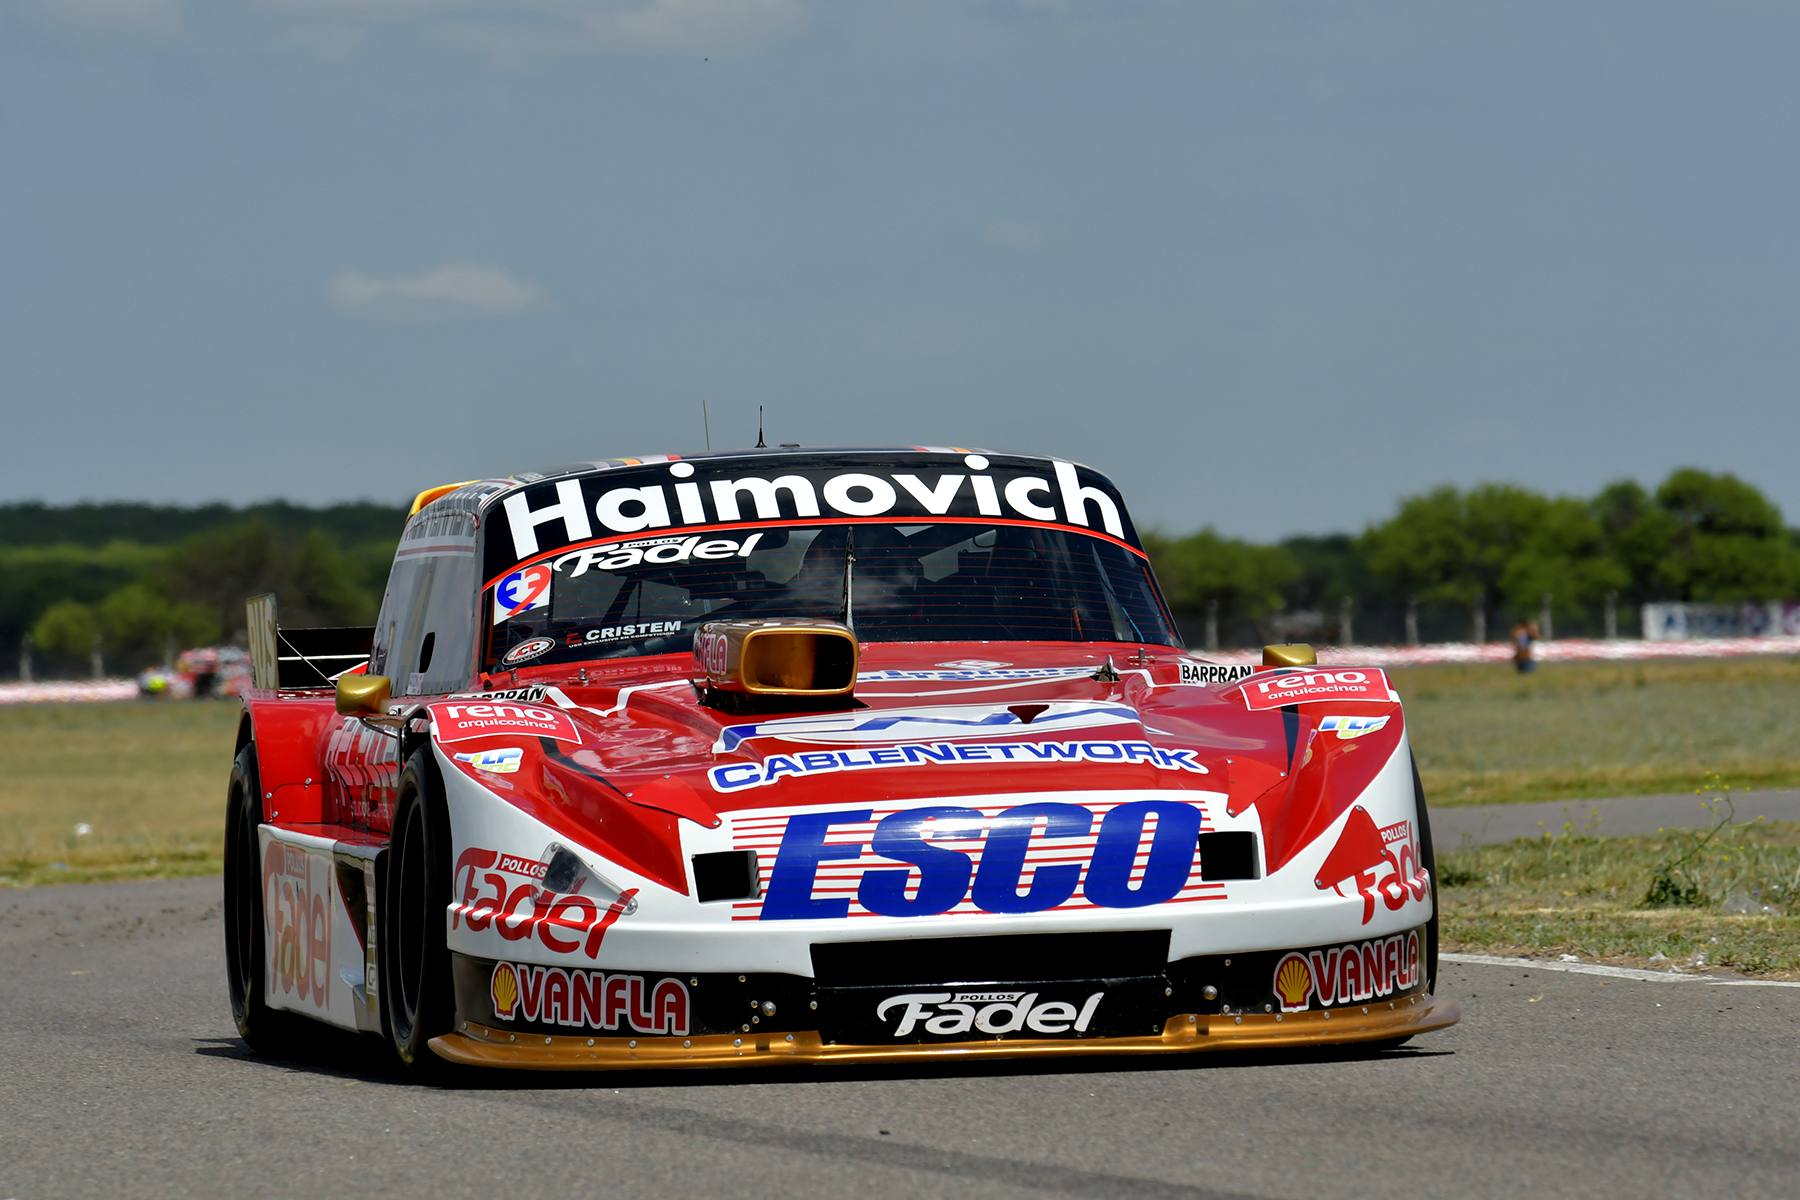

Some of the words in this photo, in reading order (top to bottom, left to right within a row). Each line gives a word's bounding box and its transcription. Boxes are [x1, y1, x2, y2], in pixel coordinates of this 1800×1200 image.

[503, 455, 1124, 561] Haimovich
[553, 533, 763, 578] Fadel
[586, 620, 682, 641] CRISTEM
[1181, 664, 1252, 684] BARPRAN
[1256, 671, 1367, 693] reno
[1268, 684, 1367, 700] arquicocinas
[446, 705, 555, 722] reno
[458, 718, 557, 730] arquicocinas
[713, 742, 1206, 791] CABLENETWORK
[1380, 824, 1408, 843] POLLOS
[501, 857, 549, 879] POLLOS
[759, 799, 1203, 921] ESCO
[453, 846, 640, 960] Fadel
[1311, 931, 1419, 1001] VANFLA
[518, 964, 688, 1033] VANFLA
[959, 993, 1016, 1002] POLLOS
[876, 991, 1105, 1037] Fadel
